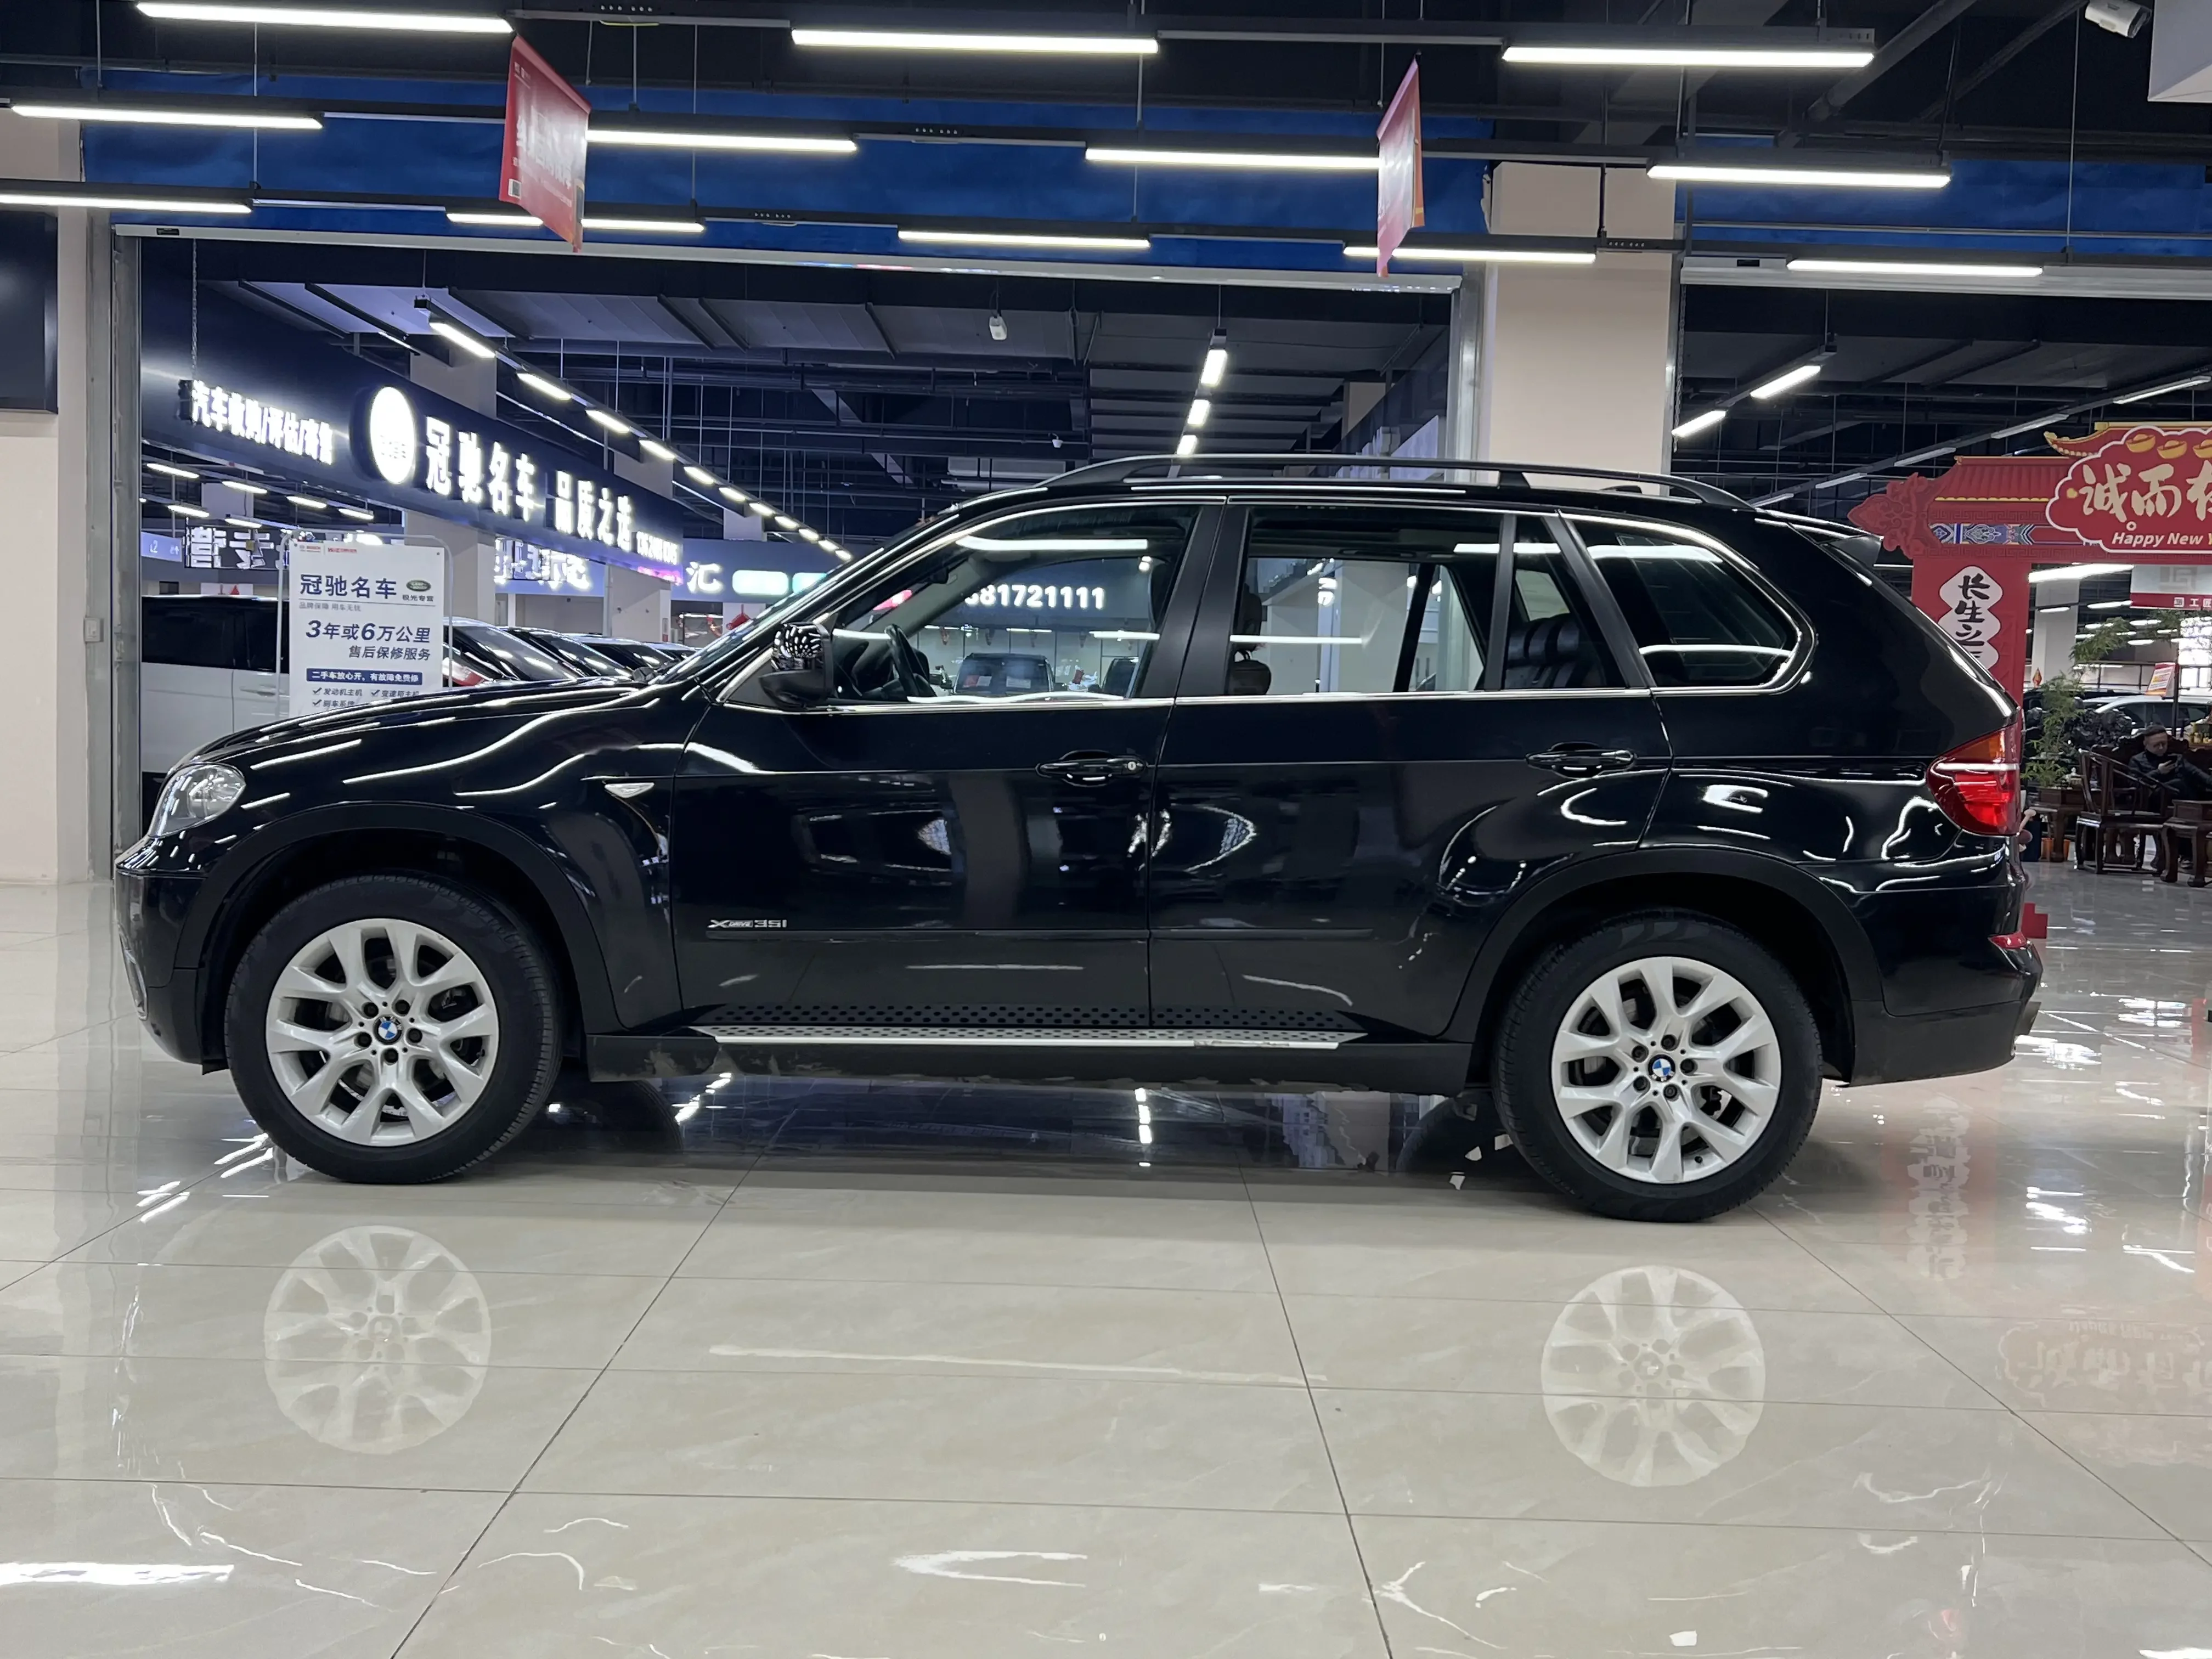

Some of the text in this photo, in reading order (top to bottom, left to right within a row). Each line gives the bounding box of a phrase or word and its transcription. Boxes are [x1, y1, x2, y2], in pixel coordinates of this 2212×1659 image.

[425, 415, 536, 522] 冠驰名车
[2112, 532, 2165, 548] Happy
[2167, 533, 2203, 545] New
[300, 574, 397, 599] 冠驰名车
[685, 561, 723, 594] 汇
[1955, 573, 1990, 658] 长生之
[306, 620, 431, 643] 3年或6万公里
[348, 645, 431, 661] 售后保修服务
